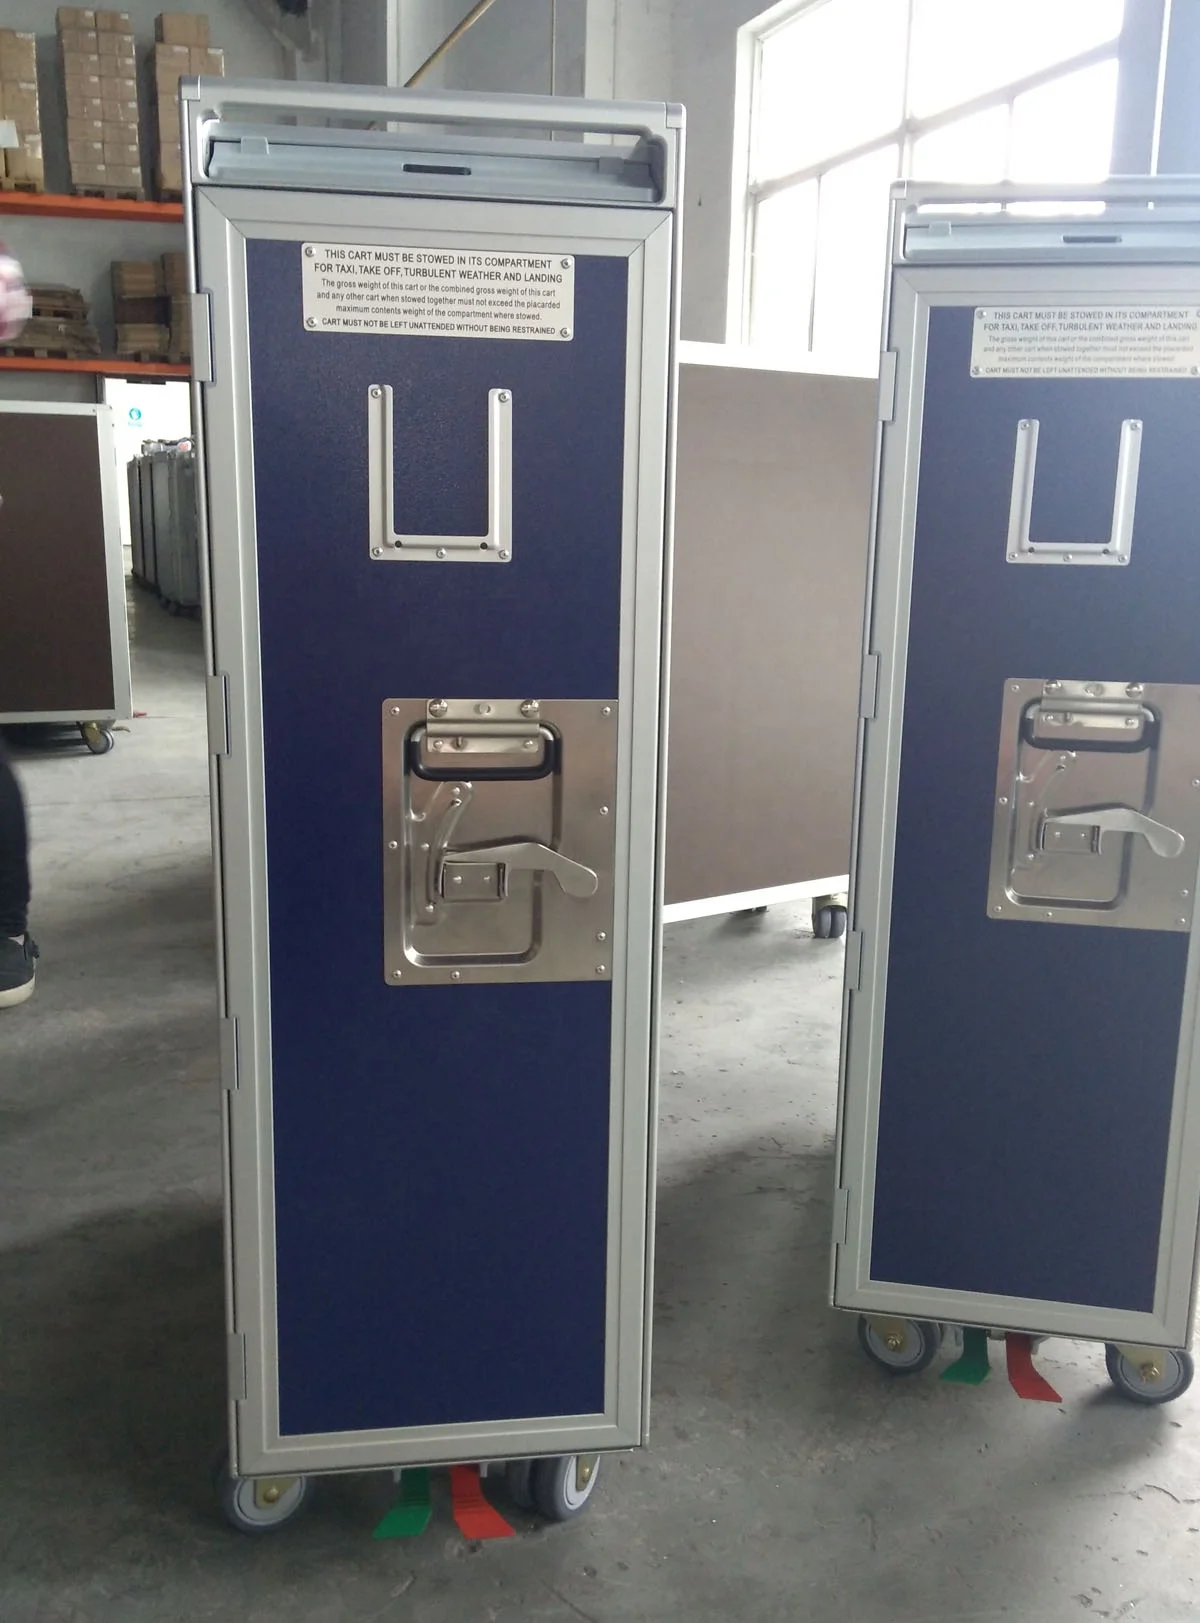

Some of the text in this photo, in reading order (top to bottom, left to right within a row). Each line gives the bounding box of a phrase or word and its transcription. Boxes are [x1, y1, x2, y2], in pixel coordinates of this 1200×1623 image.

[325, 249, 552, 269] THIS CART MUST BE STOWED IN ITS COMPARTMENT
[314, 263, 563, 283] FOR TAXI, TAKE OFF, TURBULENT WEATHER AND LANDING
[322, 279, 335, 287] The
[337, 281, 356, 289] gross
[358, 280, 381, 290] weight
[382, 281, 389, 290] of
[390, 281, 403, 290] this
[405, 283, 418, 291] cart
[429, 284, 439, 292] the
[441, 285, 474, 294] combined
[476, 286, 495, 295] gross
[497, 287, 519, 297] weight
[520, 287, 528, 295] of
[528, 288, 541, 296] this
[542, 289, 555, 297] cart
[331, 292, 344, 301] any
[381, 294, 400, 302] when
[401, 295, 426, 303] stowed
[427, 296, 457, 305] together
[458, 297, 474, 306] must
[476, 298, 486, 306] not
[488, 299, 512, 307] exceed
[514, 299, 525, 308] the
[526, 300, 560, 309] placarded
[336, 305, 369, 313] maximum
[371, 306, 401, 314] contents
[403, 307, 425, 317] weight
[427, 308, 434, 316] of
[435, 308, 446, 316] the
[447, 309, 492, 319] compartment
[493, 310, 514, 319] where
[994, 312, 1011, 320] THIS
[1070, 311, 1103, 319] STOWED
[1105, 311, 1113, 319] IN
[1115, 311, 1127, 319] ITS
[1129, 311, 1189, 319] COMPARTMENT
[322, 317, 341, 326] CART
[342, 318, 362, 326] MUST
[379, 320, 388, 328] BE
[390, 321, 408, 329] LEFT
[409, 322, 455, 330] UNATTENDED
[456, 324, 488, 332] WITHOUT
[490, 325, 510, 333] BEING
[512, 326, 555, 335] RESTRAINED
